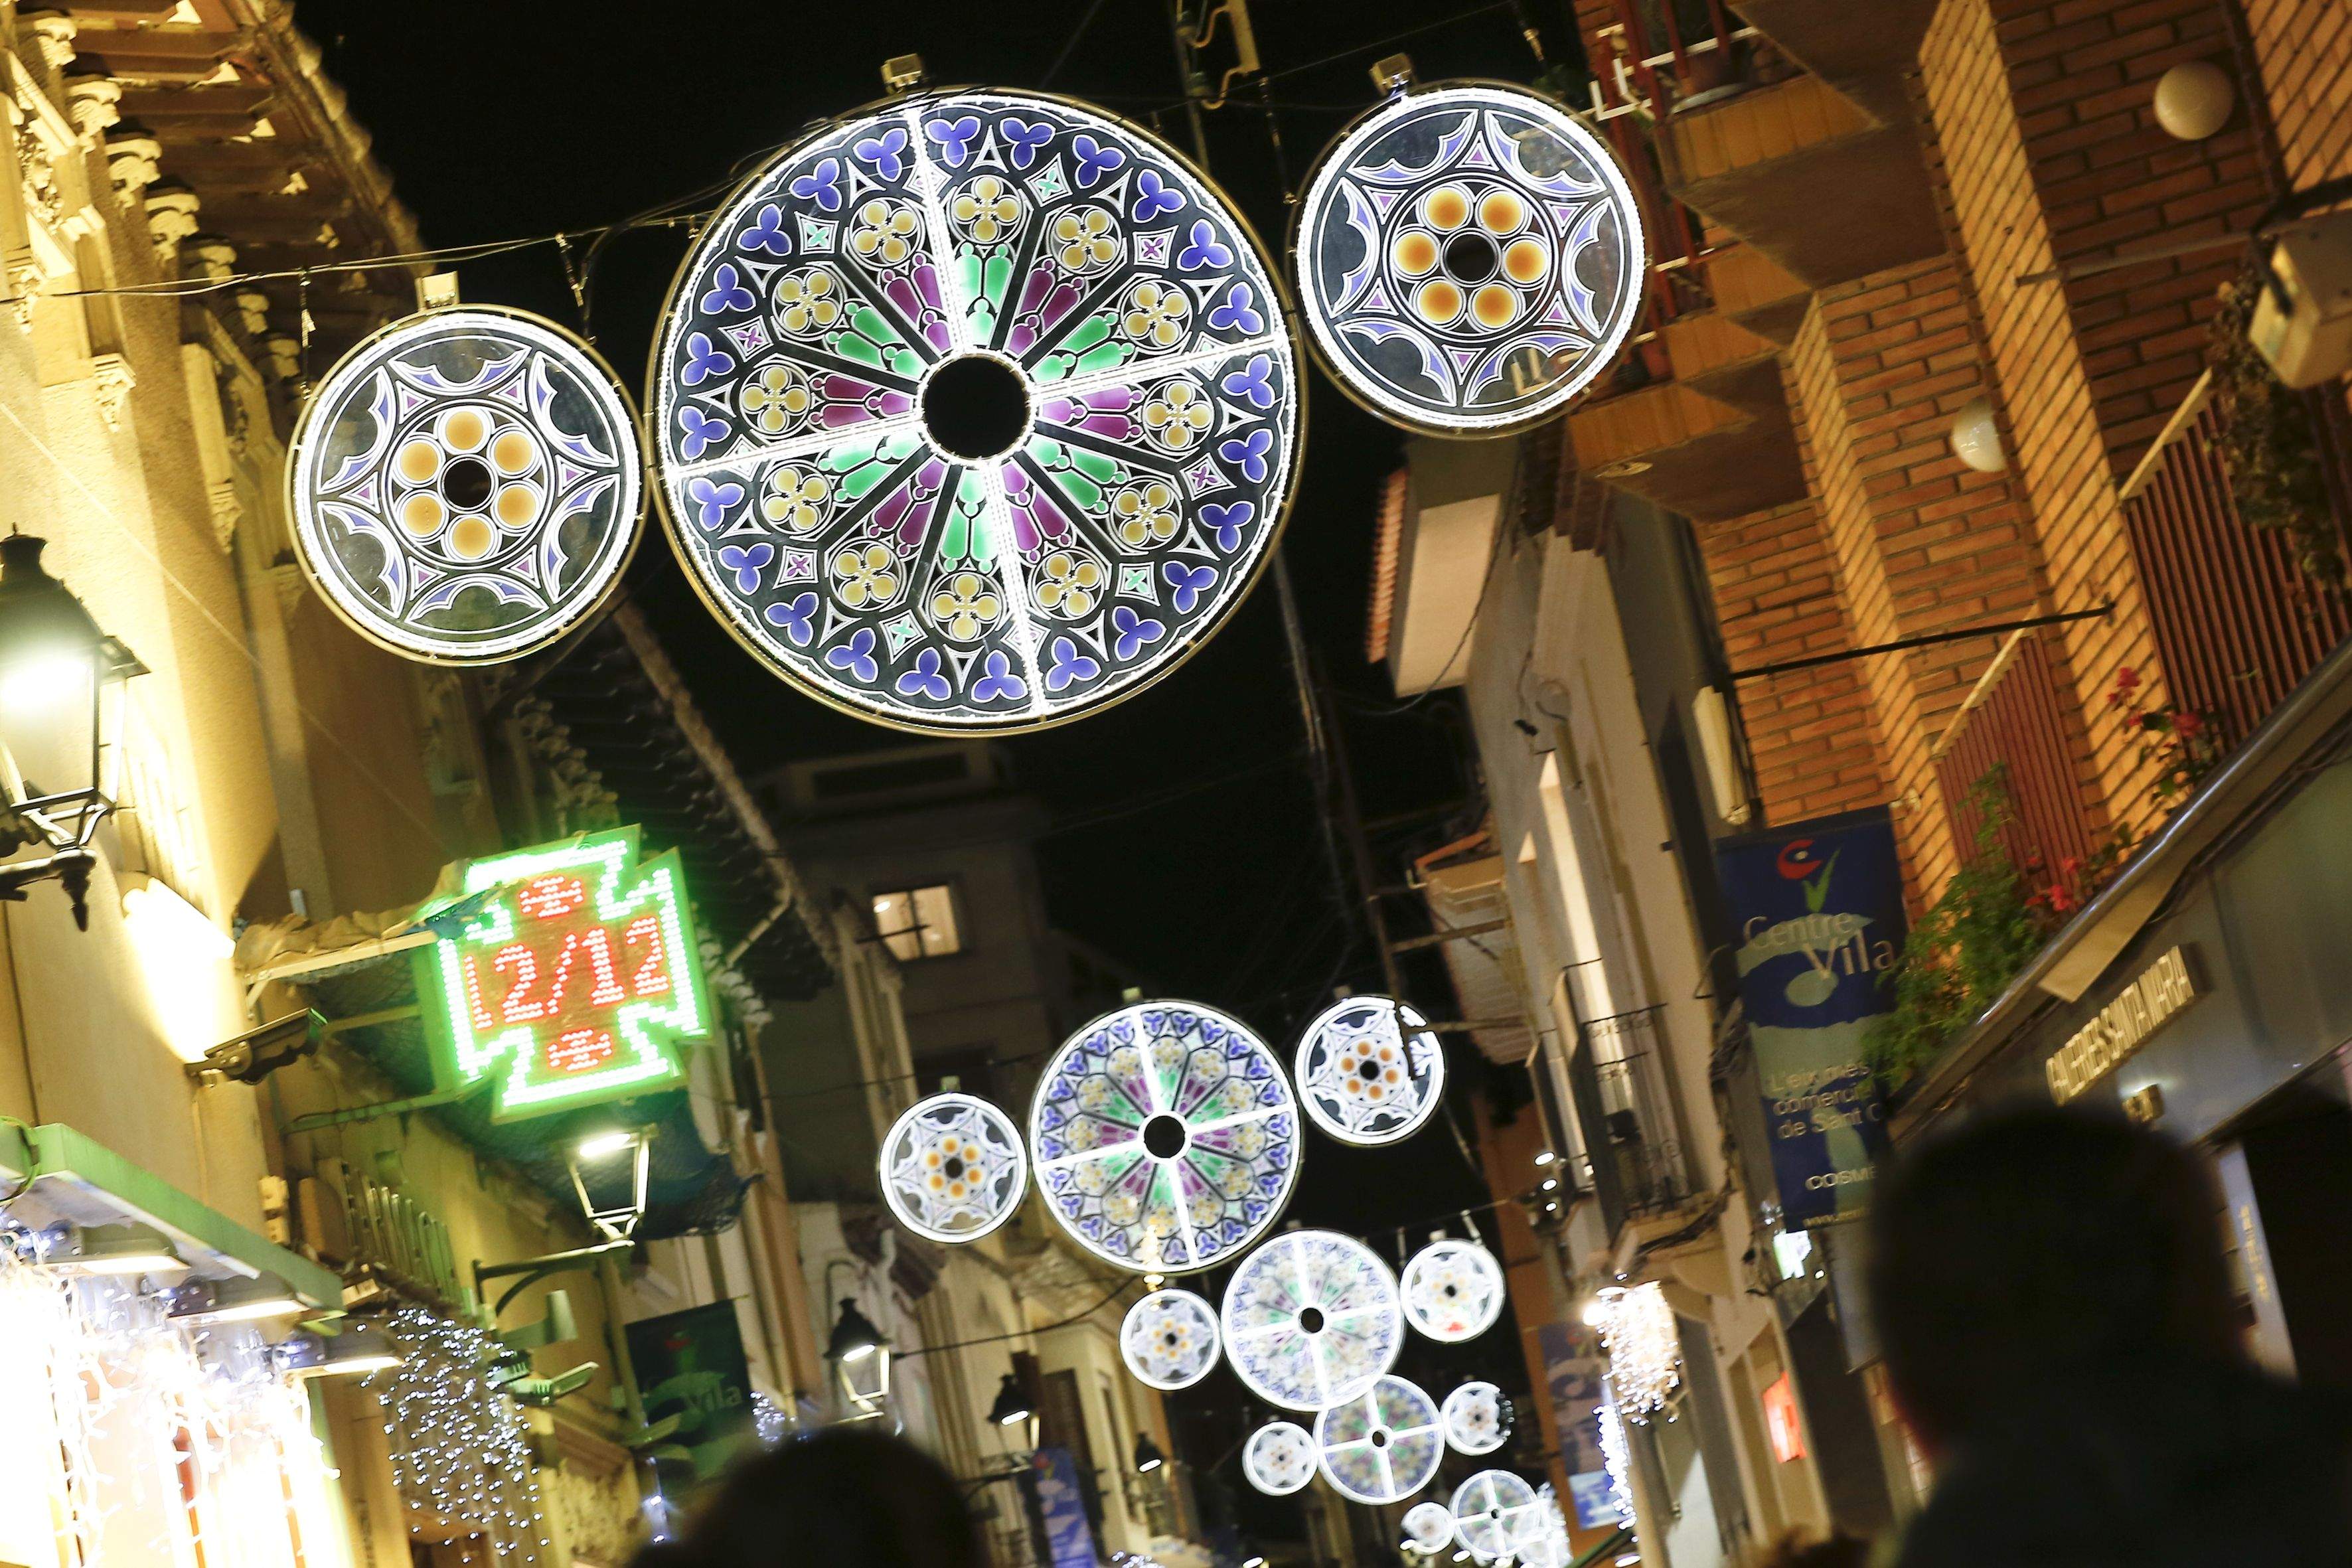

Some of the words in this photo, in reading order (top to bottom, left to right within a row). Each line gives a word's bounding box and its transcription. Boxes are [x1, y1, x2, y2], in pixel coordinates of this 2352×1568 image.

[1743, 912, 1854, 949] Centre
[1802, 928, 1894, 980] Vila
[1777, 1119, 1807, 1140] de
[1810, 1107, 1863, 1134] Sant
